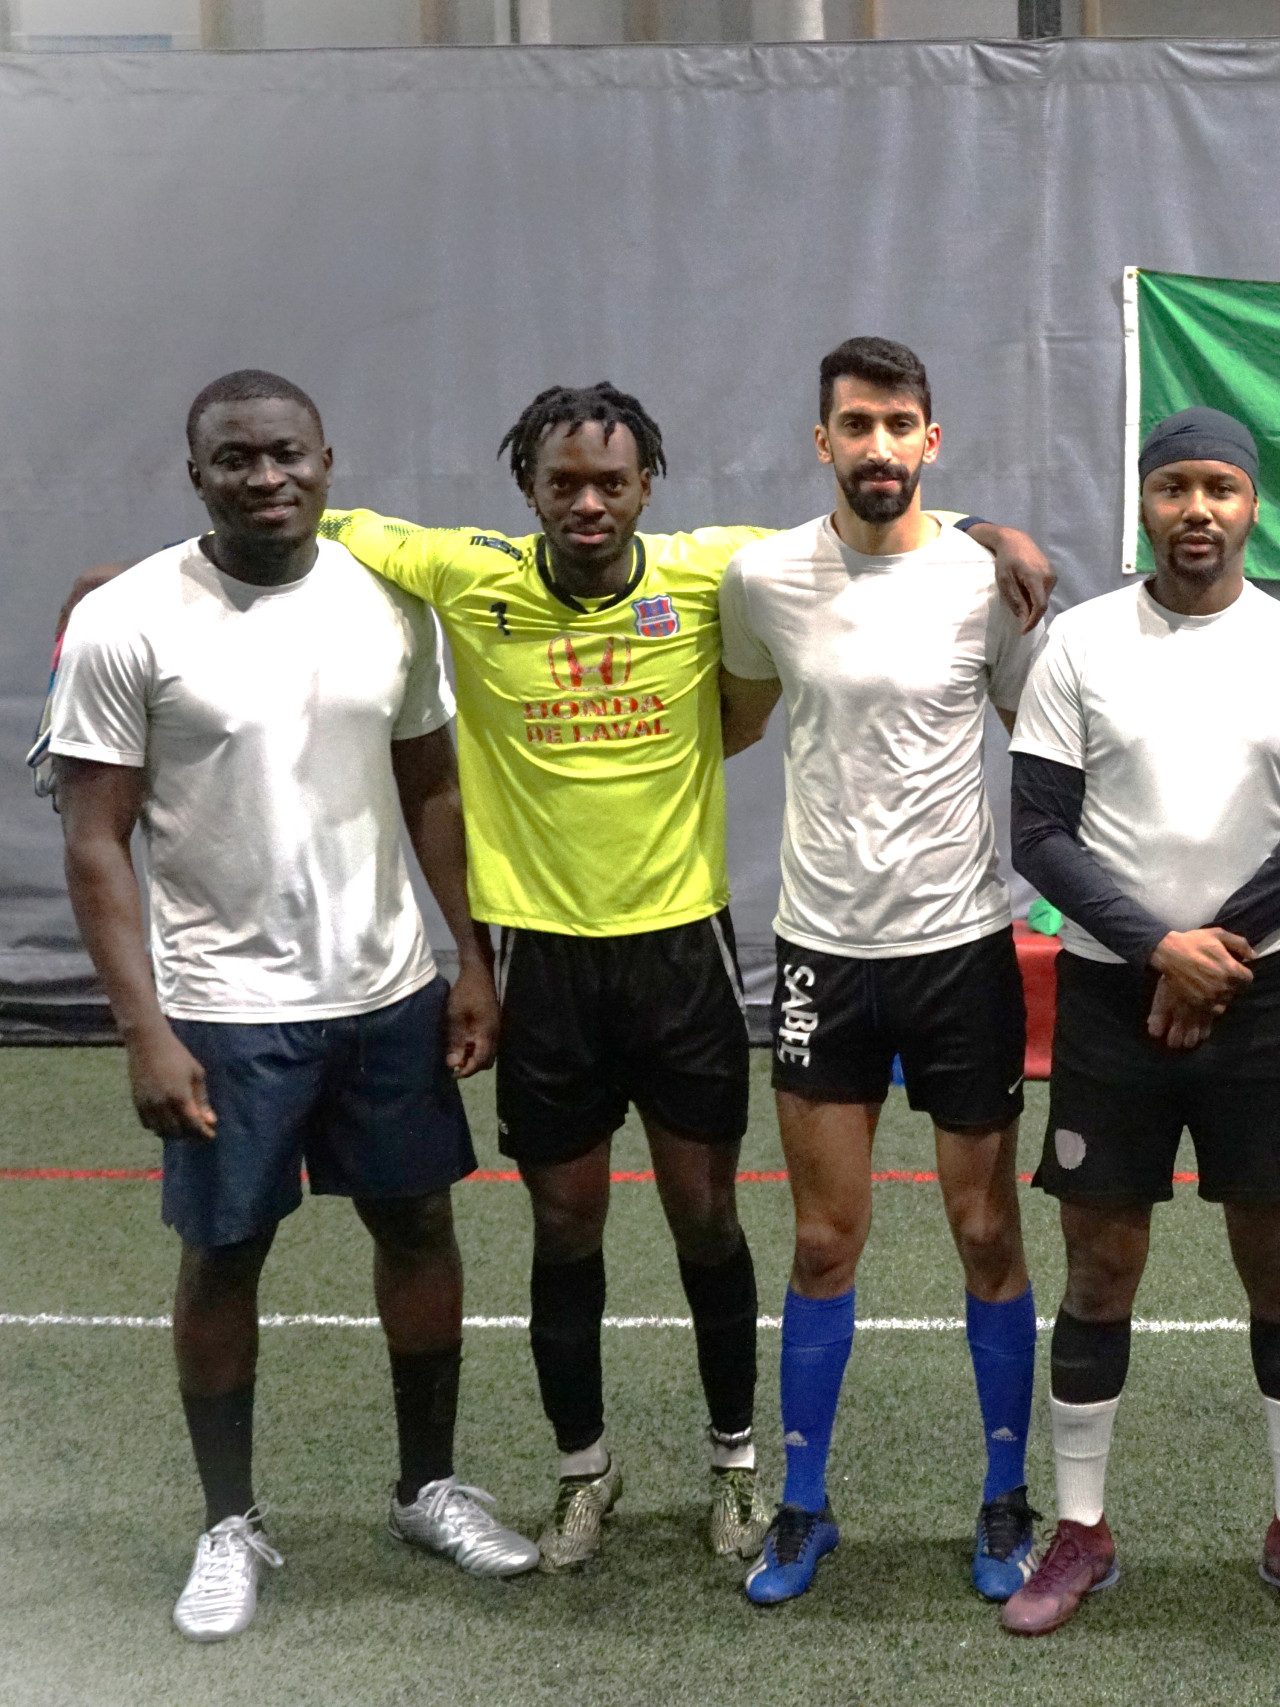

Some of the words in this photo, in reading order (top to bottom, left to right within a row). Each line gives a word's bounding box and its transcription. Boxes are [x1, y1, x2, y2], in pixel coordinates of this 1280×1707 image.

[522, 694, 665, 720] HONDA
[526, 725, 563, 744] DE
[573, 718, 671, 743] LAVAL
